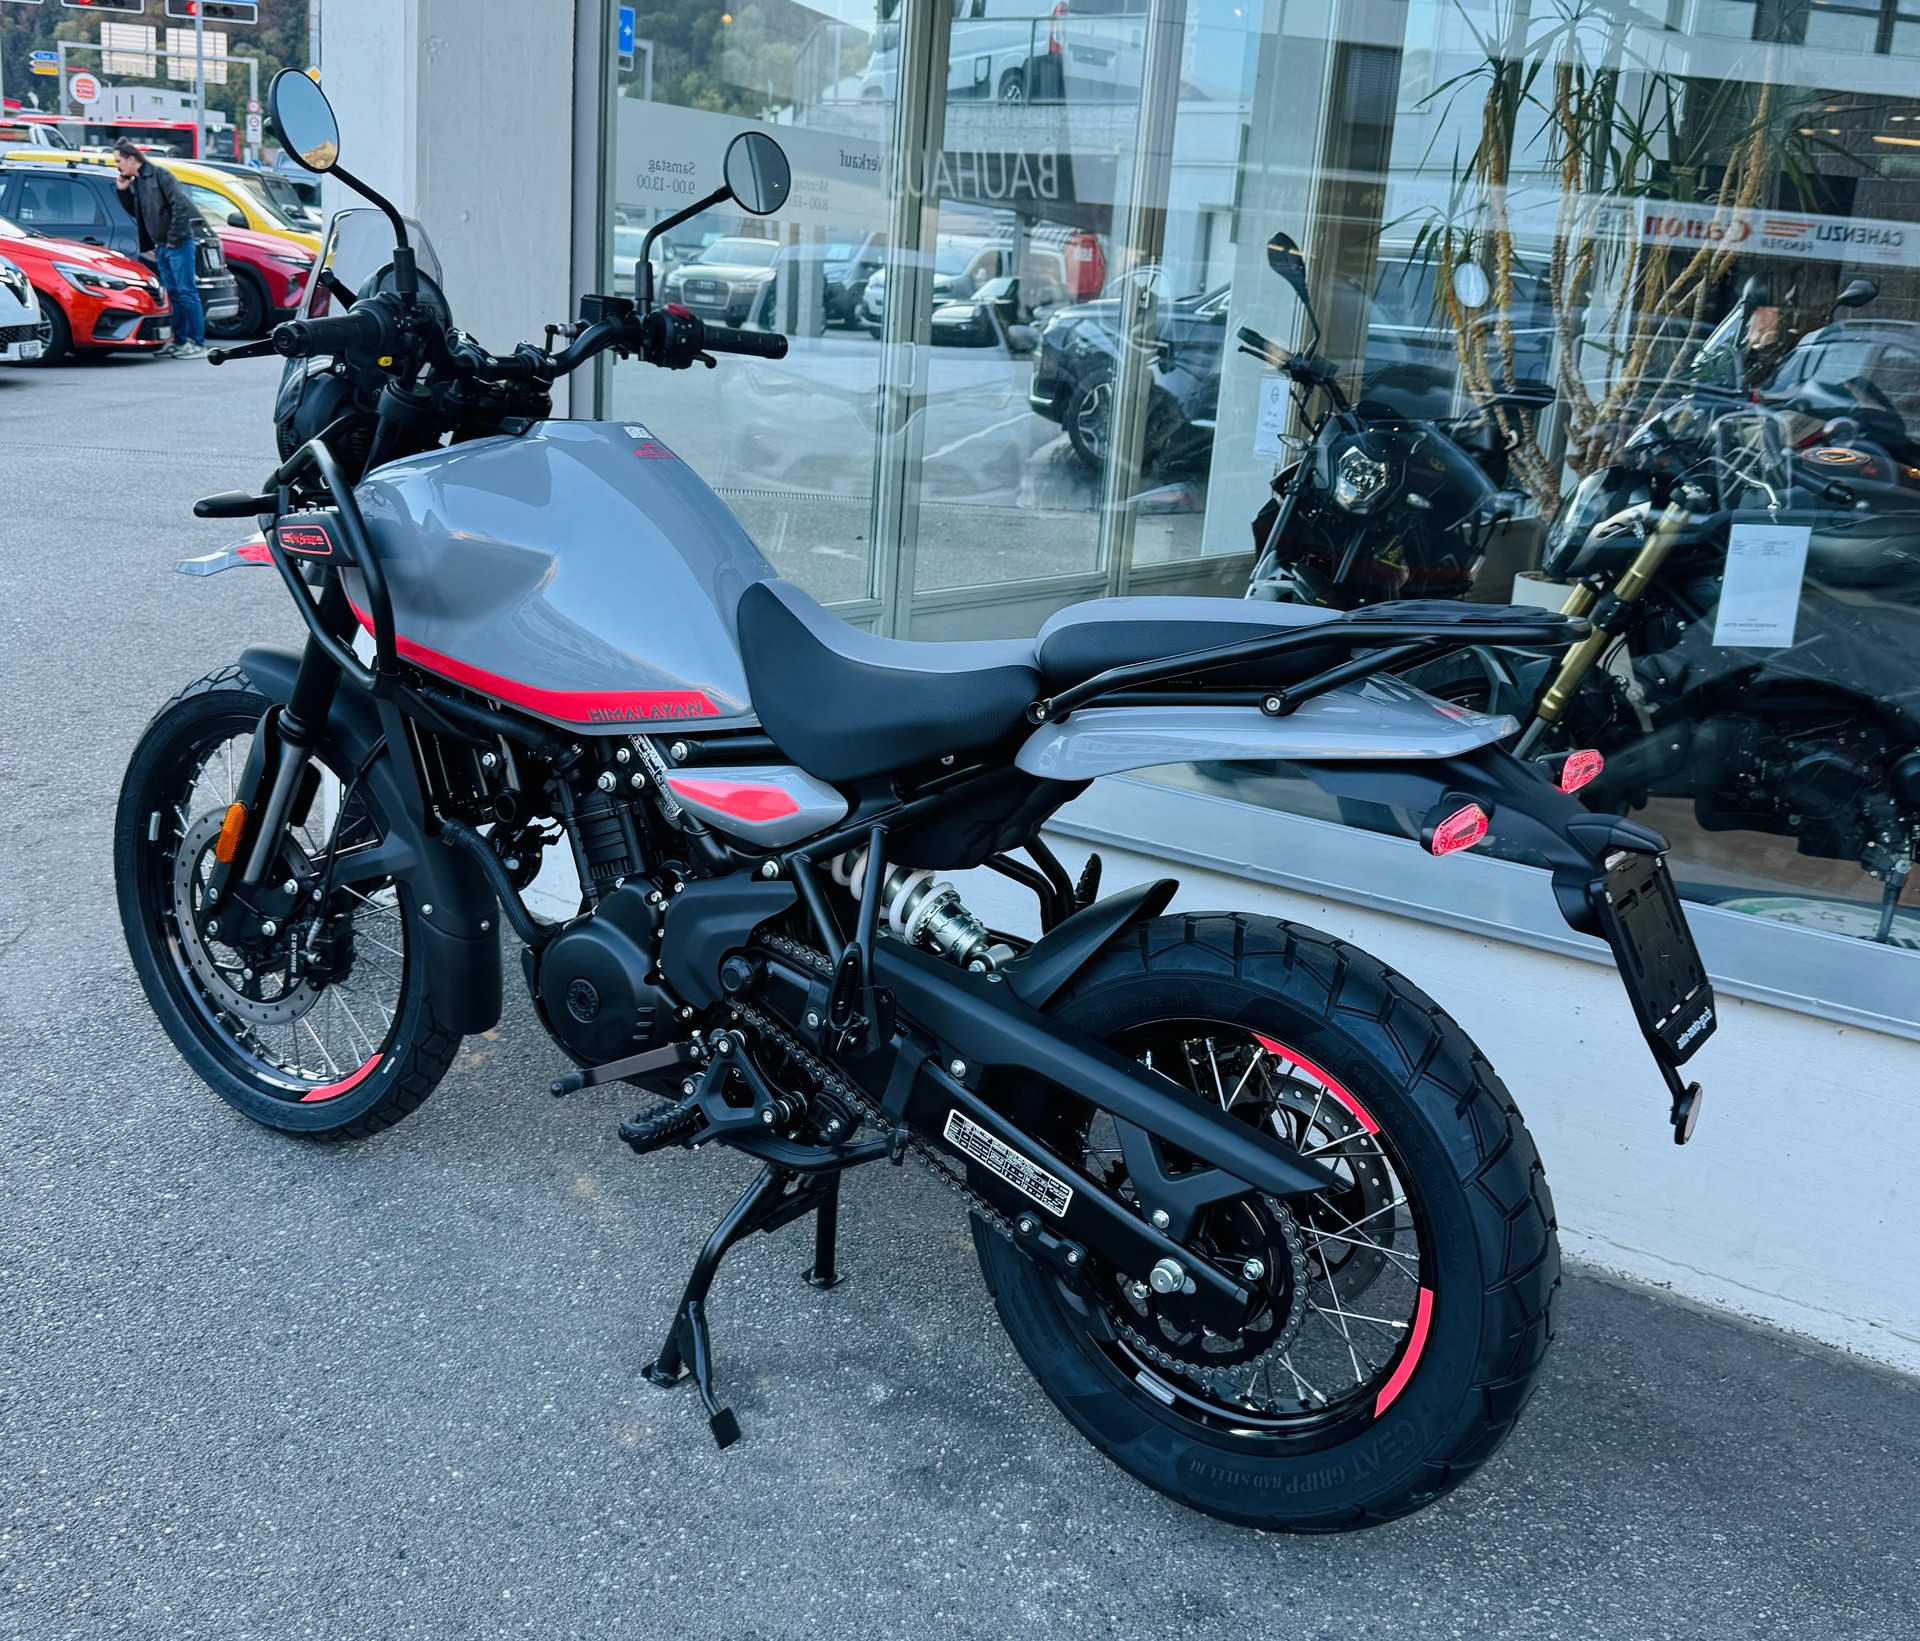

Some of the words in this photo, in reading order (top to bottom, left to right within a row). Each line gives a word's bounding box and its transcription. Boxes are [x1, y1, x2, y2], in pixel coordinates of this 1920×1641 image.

[587, 700, 703, 722] HIMALAYAN
[1350, 1418, 1417, 1482] CEAT
[1209, 1465, 1249, 1485] STEEL
[1253, 1475, 1282, 1489] RAD
[1285, 1464, 1346, 1494] GRIPP
